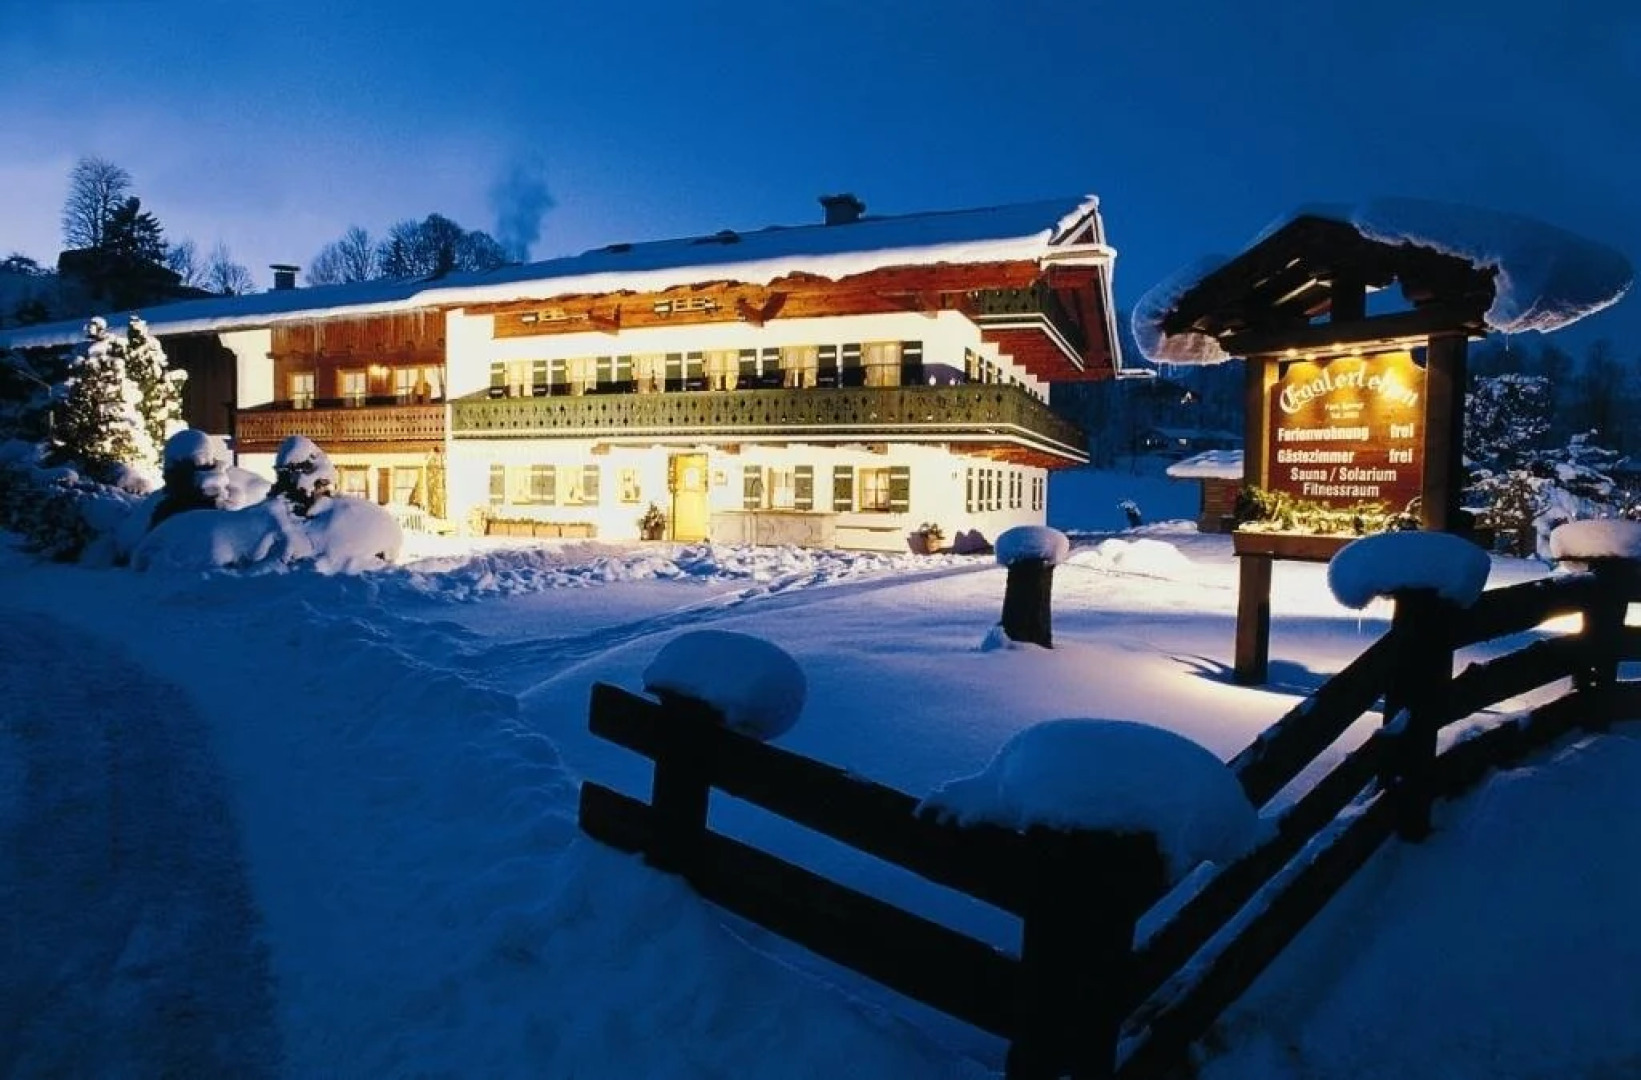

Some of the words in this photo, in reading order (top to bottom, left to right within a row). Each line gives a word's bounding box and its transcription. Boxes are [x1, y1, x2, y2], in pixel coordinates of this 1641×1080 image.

[1278, 426, 1369, 441] Ferienwohnung
[1390, 423, 1414, 438] frei
[1277, 448, 1355, 463] Gästezimmer
[1388, 448, 1413, 463] frei
[1290, 466, 1328, 481] Sauna
[1339, 466, 1397, 481] Solarium
[1303, 482, 1379, 497] Fitnessraum
